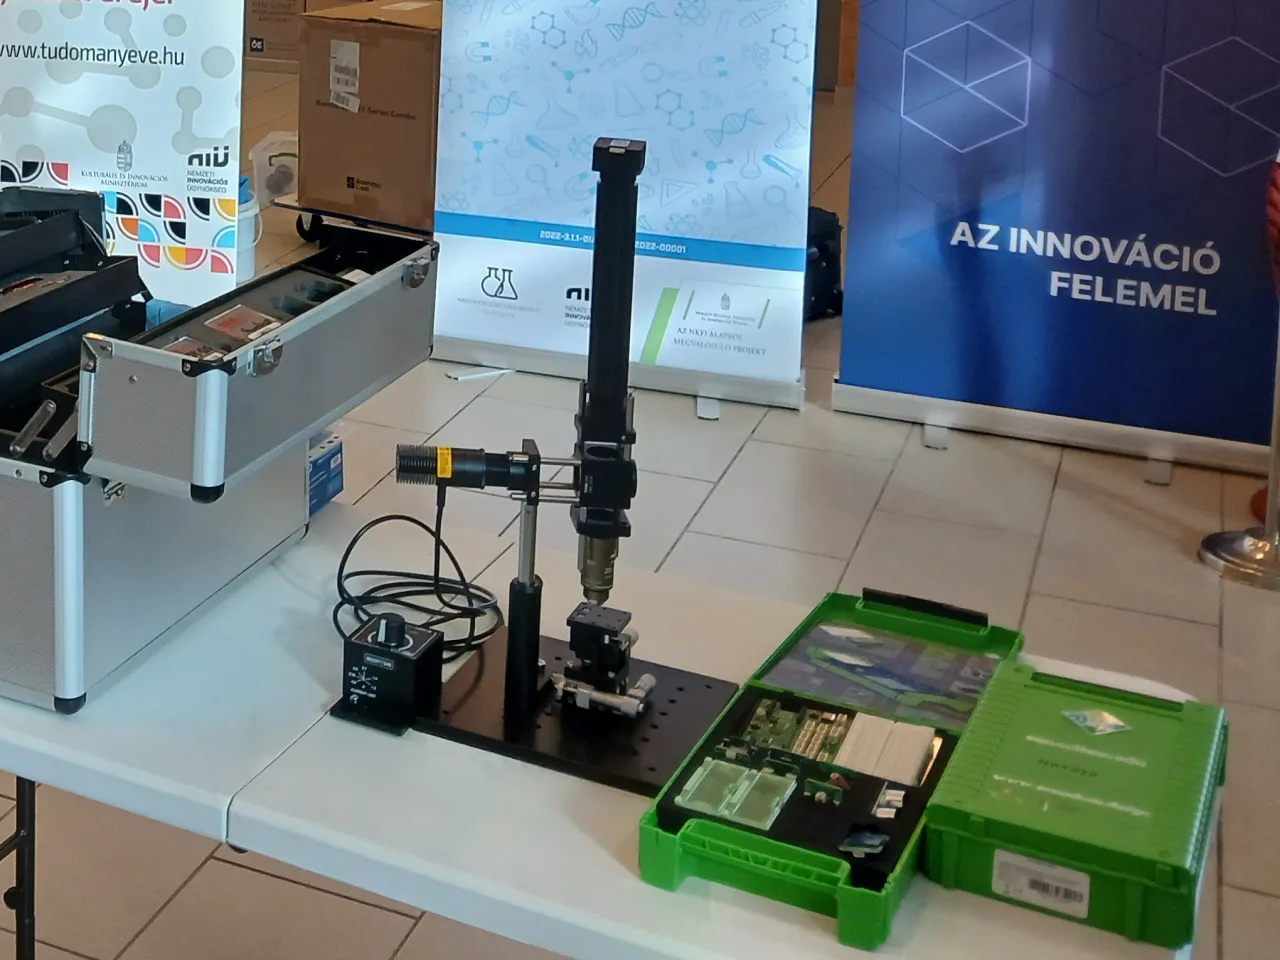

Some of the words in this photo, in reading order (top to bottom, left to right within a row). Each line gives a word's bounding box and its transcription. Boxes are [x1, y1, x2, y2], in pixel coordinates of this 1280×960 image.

[187, 170, 215, 178] NEMZETI
[187, 176, 228, 186] INNOVÁCIÓS
[950, 221, 1000, 251] AZ
[1009, 227, 1221, 275] INNOVÁCIÓ
[1050, 271, 1217, 316] FELEMEL
[677, 327, 687, 335] AZ
[689, 328, 708, 338] NKFI
[733, 345, 767, 356] PROJEKT
